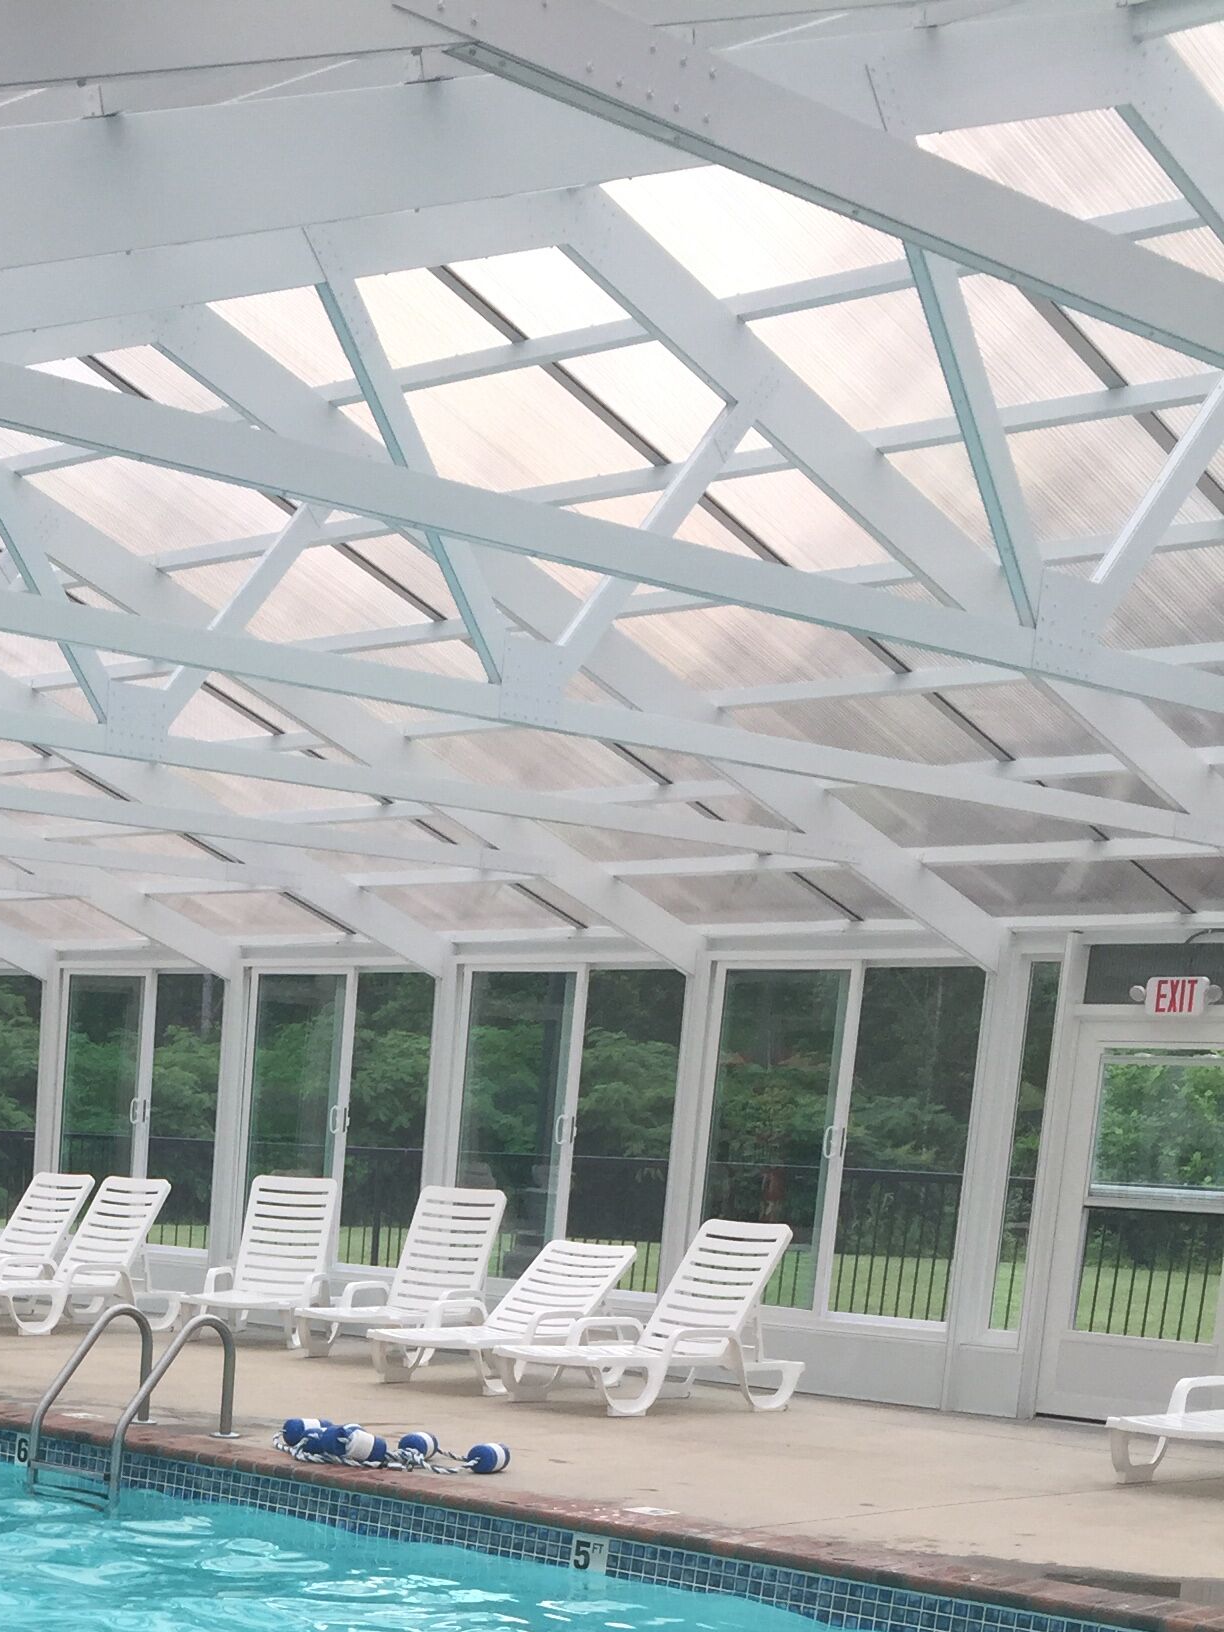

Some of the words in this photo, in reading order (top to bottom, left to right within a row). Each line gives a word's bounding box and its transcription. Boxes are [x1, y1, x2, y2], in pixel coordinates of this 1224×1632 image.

[1154, 979, 1198, 1013] EXIT
[17, 1437, 28, 1463] 6
[573, 1539, 591, 1570] 5
[592, 1542, 604, 1554] FT
